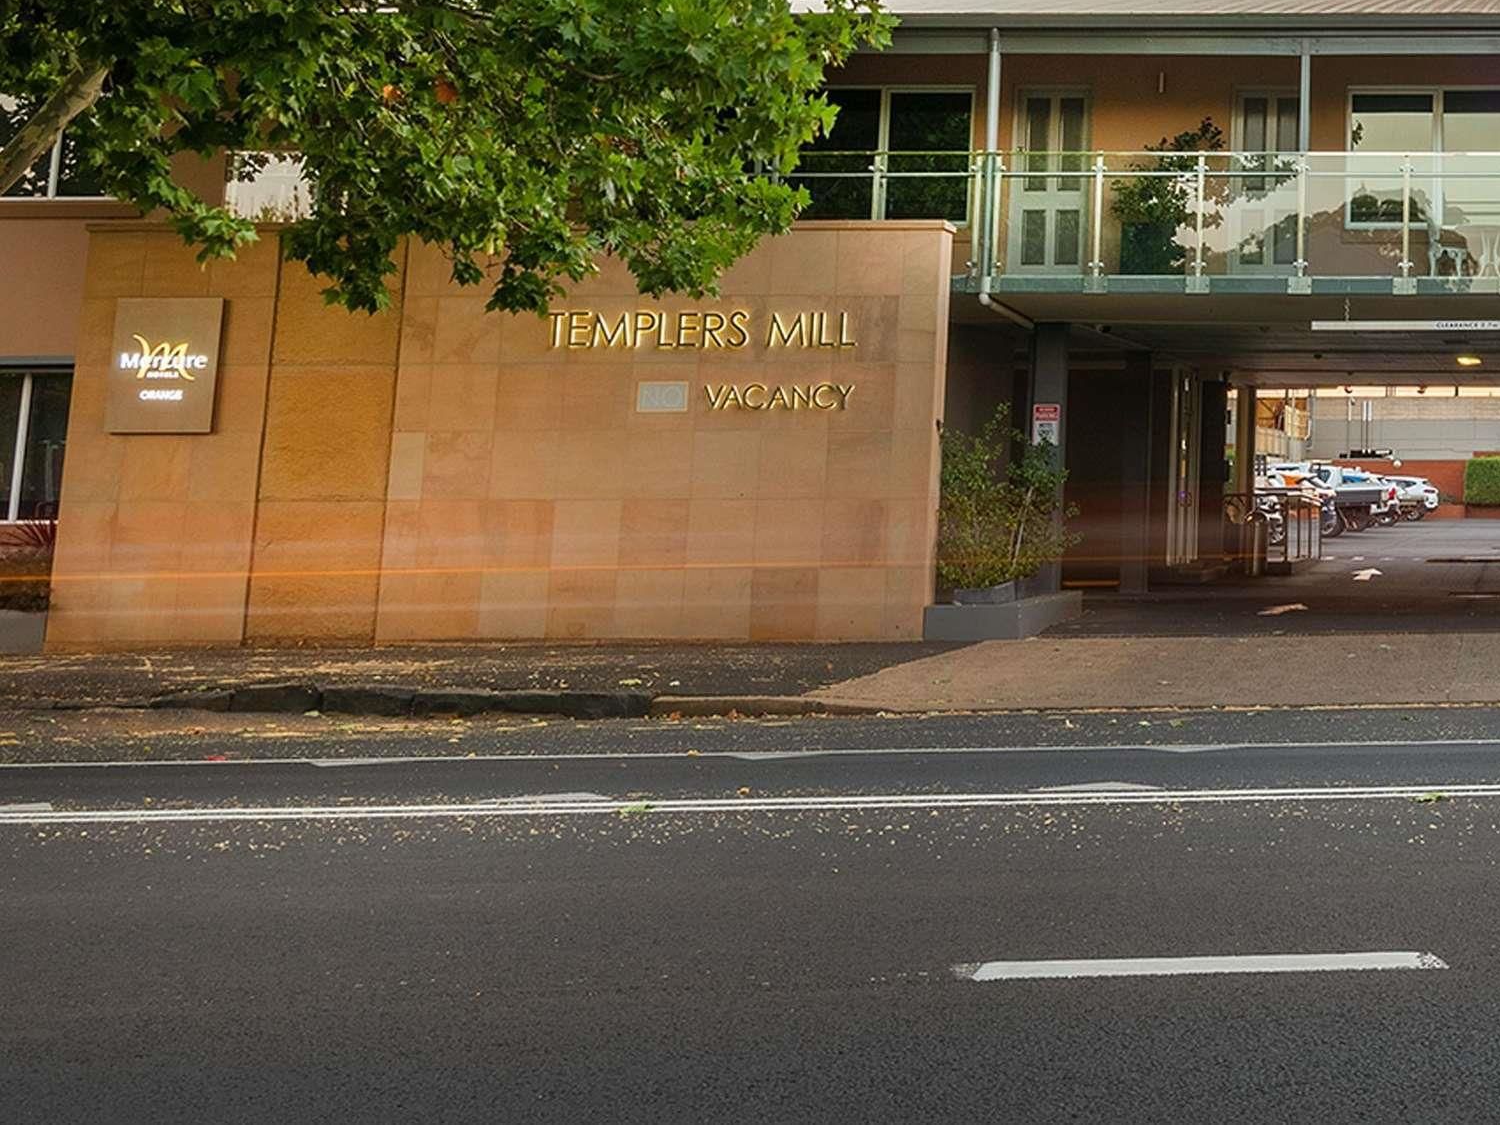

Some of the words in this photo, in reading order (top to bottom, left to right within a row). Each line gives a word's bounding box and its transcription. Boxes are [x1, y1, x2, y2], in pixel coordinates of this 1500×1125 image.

[549, 311, 751, 348] TEMPLERS
[766, 311, 857, 348] MILL
[704, 383, 855, 410] VACANCY
